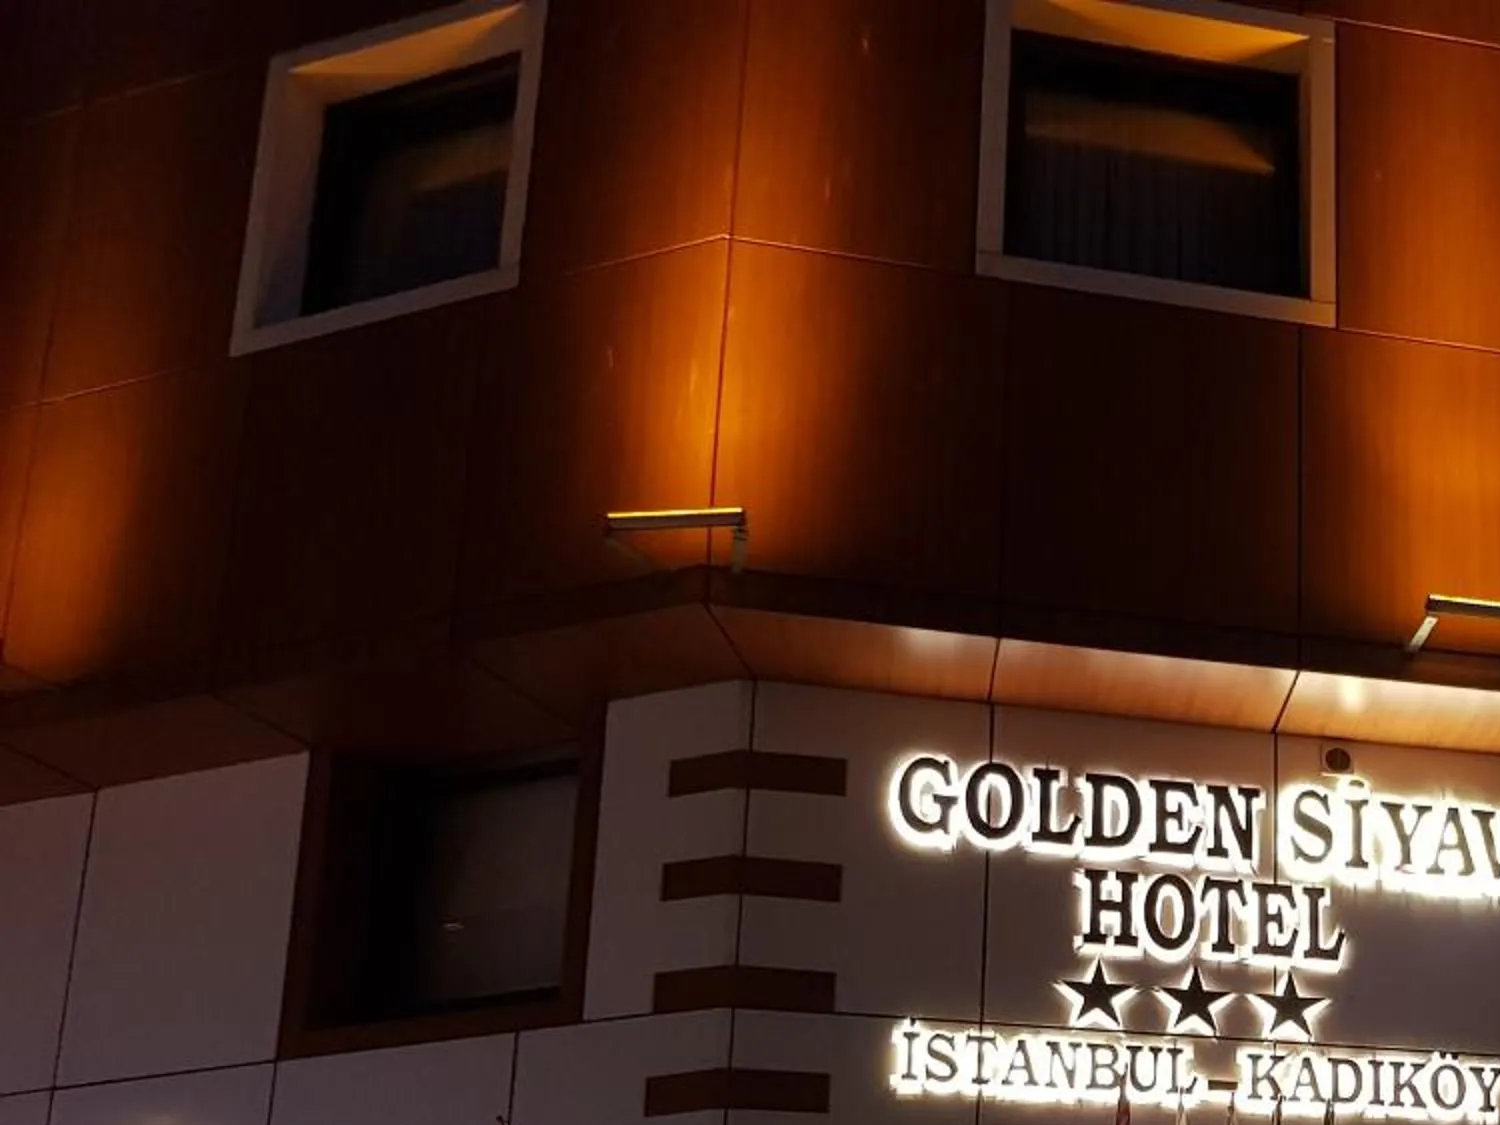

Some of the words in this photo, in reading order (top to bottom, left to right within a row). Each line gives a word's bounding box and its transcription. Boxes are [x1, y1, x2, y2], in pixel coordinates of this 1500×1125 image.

[898, 756, 1261, 862] GOLDEN
[1082, 869, 1346, 961] HOTEL
[900, 1016, 1198, 1095] İSTANBUL
